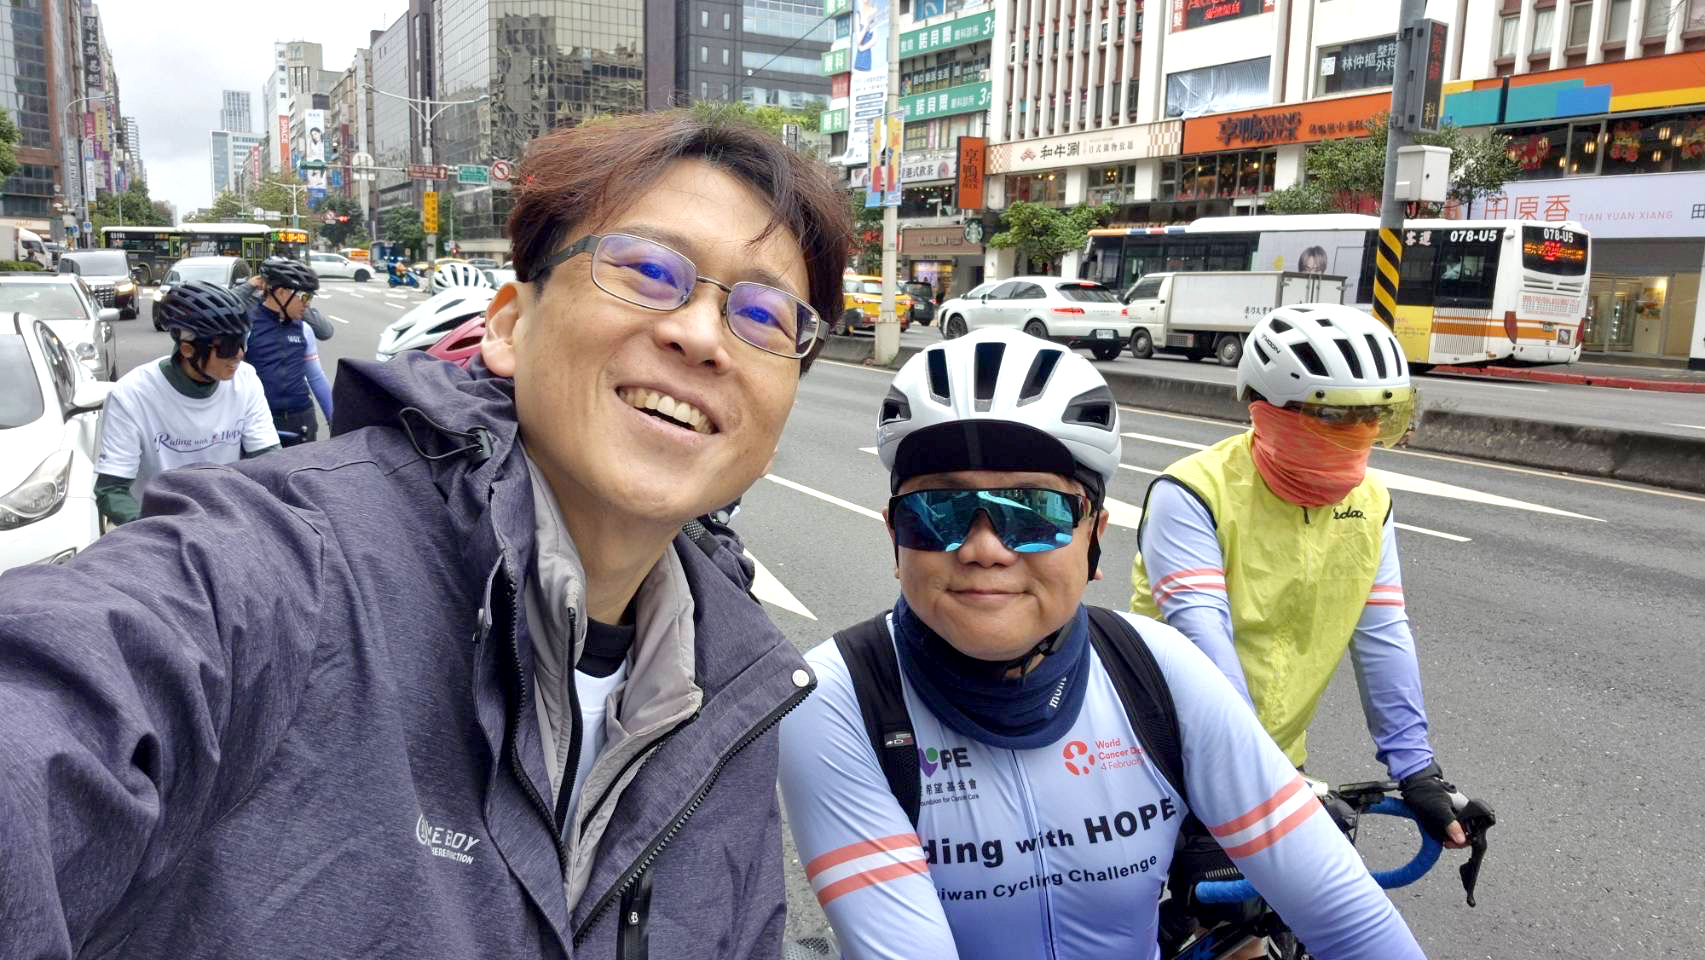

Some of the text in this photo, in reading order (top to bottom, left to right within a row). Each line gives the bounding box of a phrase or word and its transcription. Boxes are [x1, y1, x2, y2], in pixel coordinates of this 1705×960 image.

[1484, 194, 1572, 222] 田原香
[1579, 209, 1674, 222] TIAN YUAN XIANG
[1450, 229, 1498, 243] 078-U5
[1543, 228, 1574, 244] 078-U5
[1095, 738, 1121, 750] World
[1098, 749, 1128, 761] Cancer
[1016, 830, 1075, 854] with
[1084, 796, 1177, 844] HOPE
[993, 873, 1063, 898] Cycling
[1068, 855, 1157, 883] Challenge
